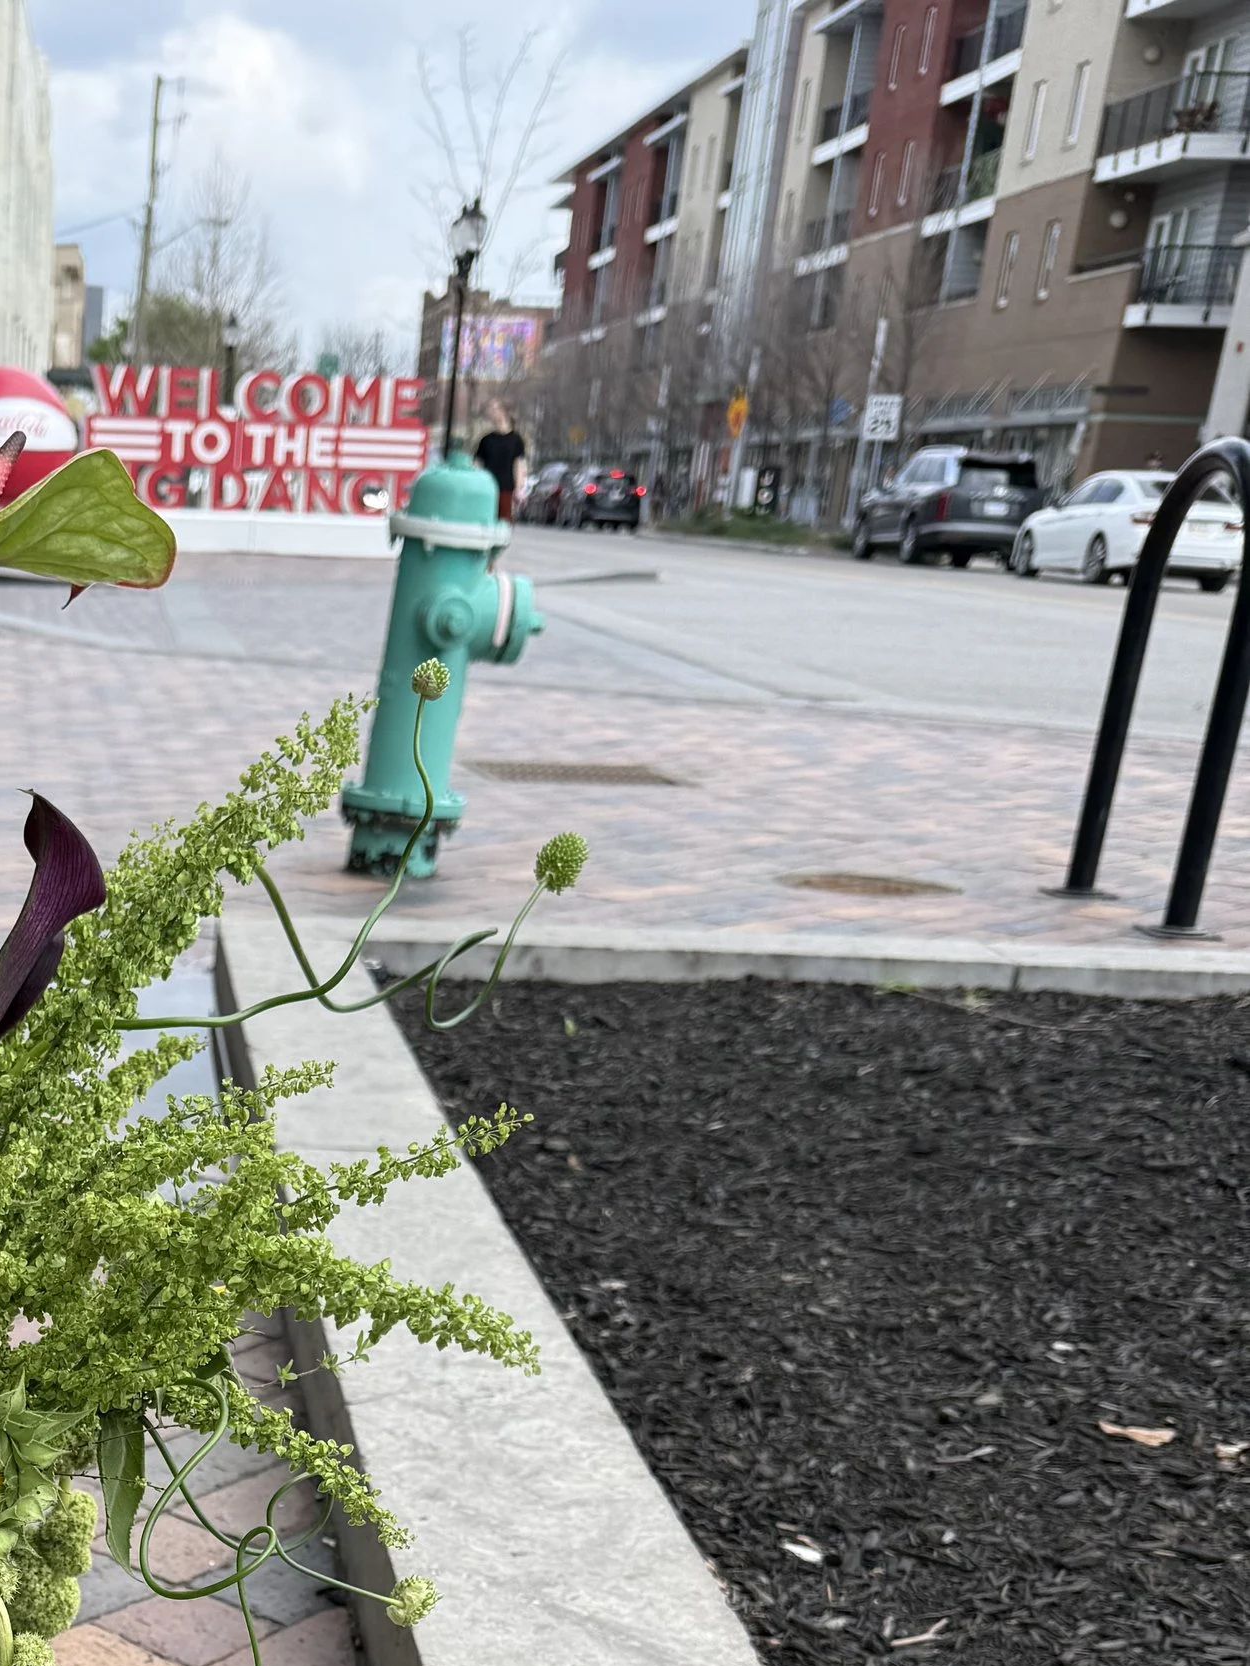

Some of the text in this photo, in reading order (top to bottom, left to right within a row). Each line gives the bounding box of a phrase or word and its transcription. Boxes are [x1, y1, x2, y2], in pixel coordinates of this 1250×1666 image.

[91, 363, 425, 427] WELCOME
[164, 420, 338, 468] TO THE
